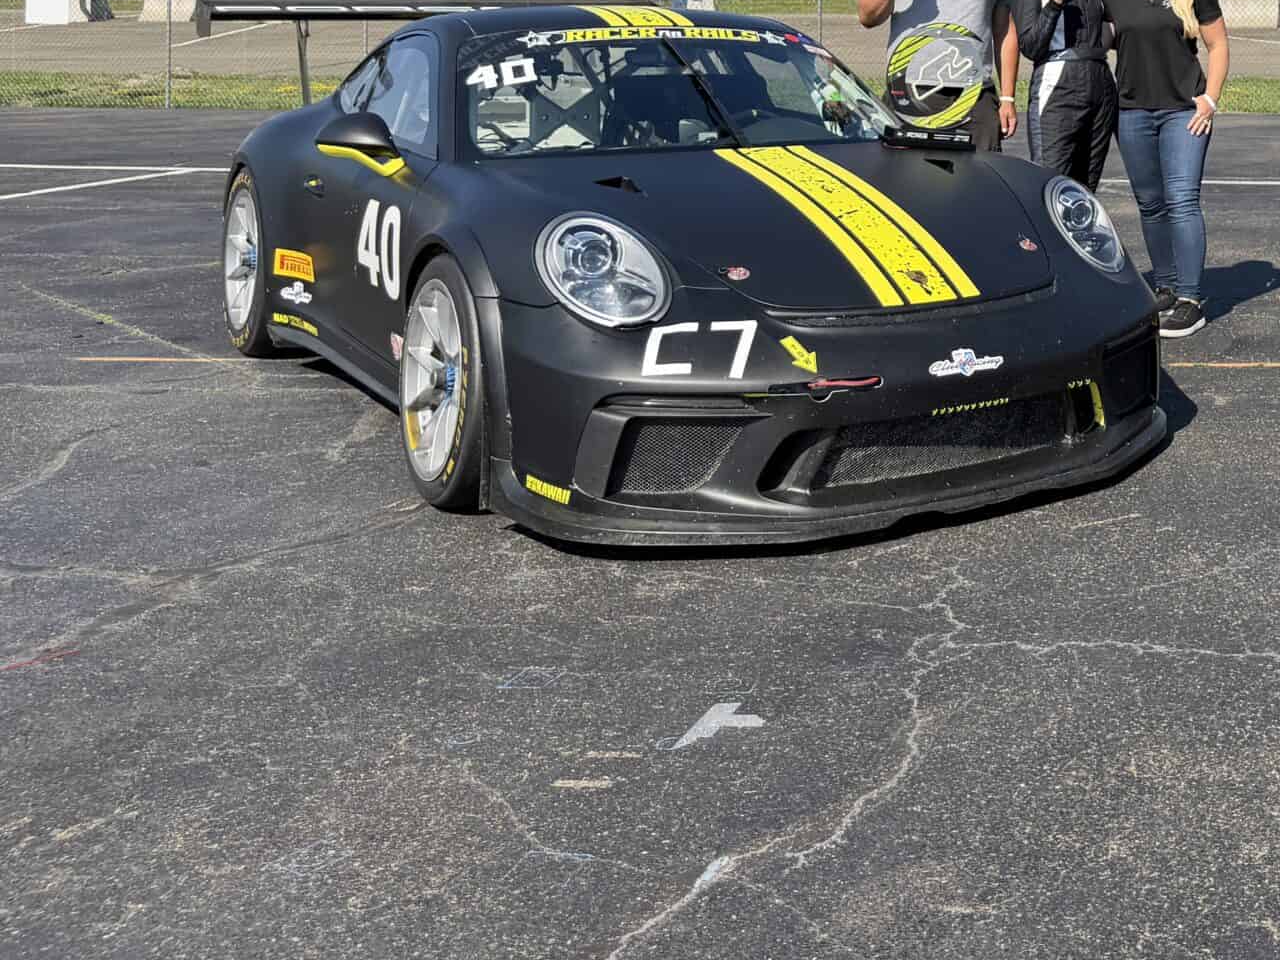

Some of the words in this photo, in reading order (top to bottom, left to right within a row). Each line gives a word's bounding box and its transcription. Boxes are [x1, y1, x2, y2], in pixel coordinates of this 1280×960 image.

[566, 27, 656, 43] RACER
[683, 28, 758, 42] RAILS
[466, 57, 537, 88] 40
[358, 199, 400, 300] 40
